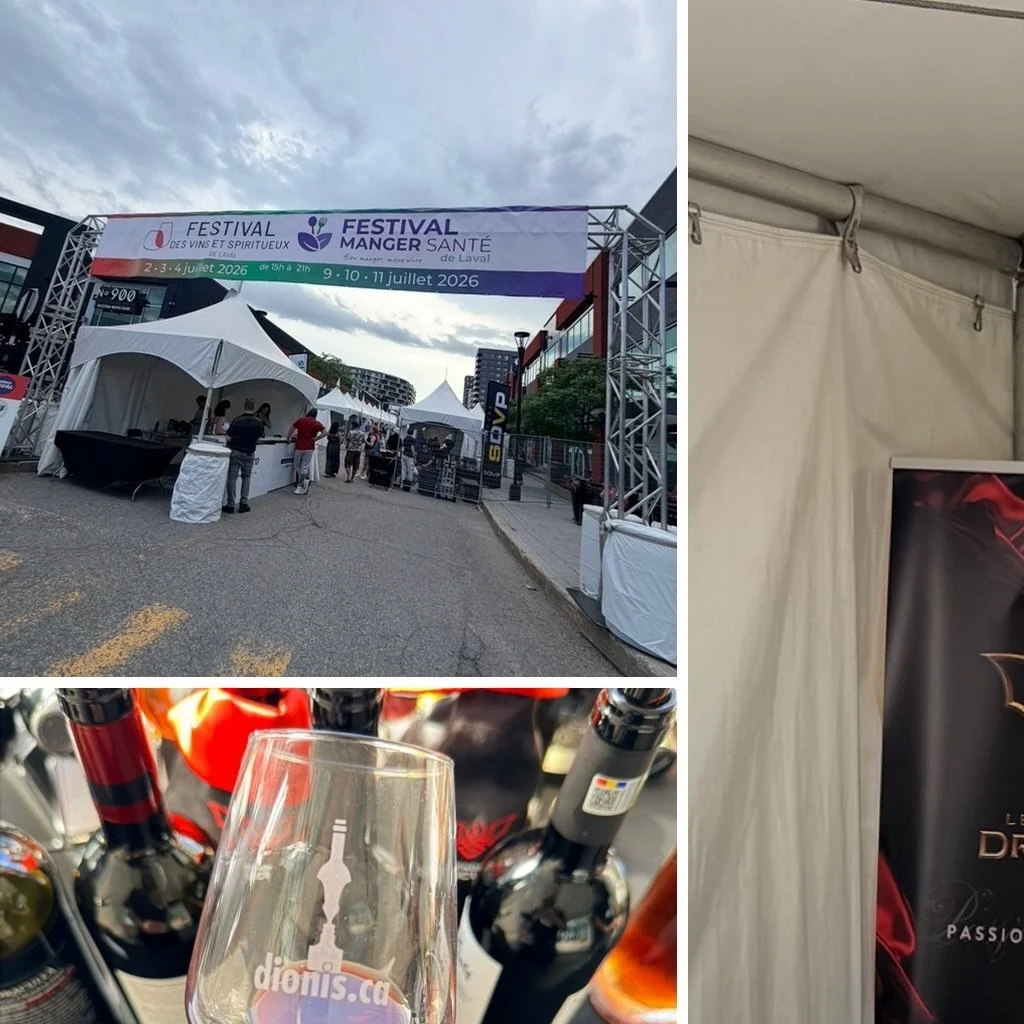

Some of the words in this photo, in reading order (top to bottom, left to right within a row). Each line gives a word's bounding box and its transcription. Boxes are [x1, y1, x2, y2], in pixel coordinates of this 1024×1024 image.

[186, 221, 276, 237] FESTIVAL
[342, 218, 459, 235] FESTIVAL
[169, 239, 187, 249] DES
[189, 239, 210, 249] VINS
[212, 239, 225, 249] ET
[229, 240, 290, 250] SPIRITUEUX
[340, 237, 421, 251] MANGER
[426, 235, 492, 252] SANTÉ
[440, 253, 455, 263] de
[458, 254, 491, 264] Laval
[144, 263, 152, 273] 2
[159, 263, 167, 273] 3
[174, 263, 182, 273] 4
[182, 262, 213, 276] juillet
[217, 263, 248, 276] 2026
[259, 263, 270, 272] de
[271, 263, 285, 272] 15h
[286, 264, 292, 272] à
[296, 264, 311, 273] 21h
[323, 268, 332, 280] 9
[344, 269, 360, 282] 10
[372, 271, 384, 284] 11
[385, 271, 433, 287] juillet
[438, 274, 479, 288] 2026
[111, 288, 136, 302] 900
[254, 952, 390, 1006] dionis.ca
